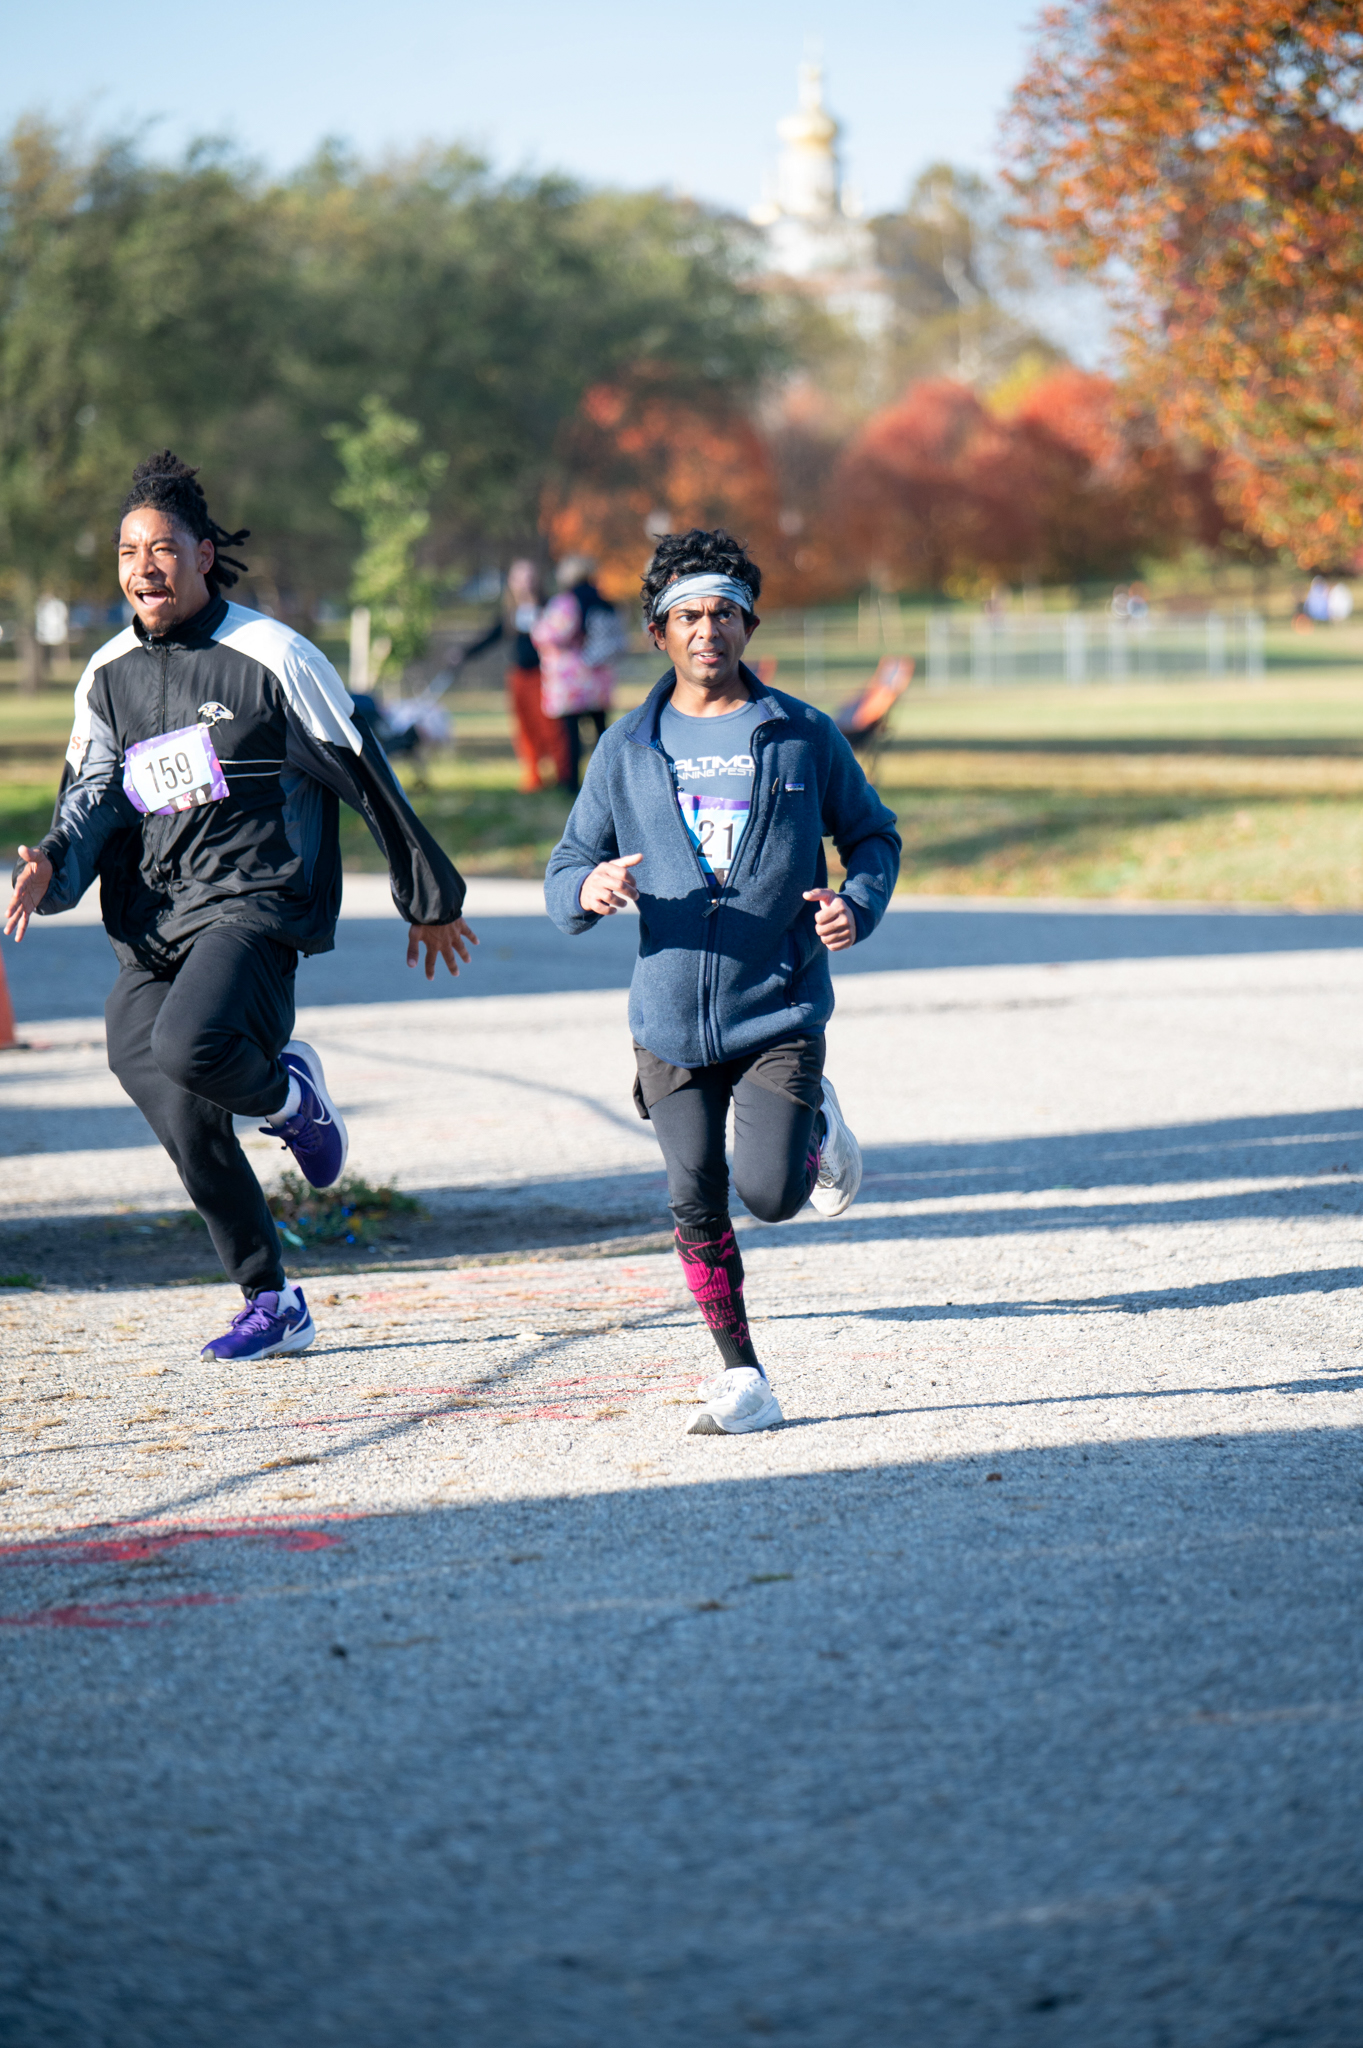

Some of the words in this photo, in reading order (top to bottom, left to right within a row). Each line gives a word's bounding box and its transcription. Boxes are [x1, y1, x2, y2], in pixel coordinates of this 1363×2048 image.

[144, 752, 194, 793] 159
[668, 755, 755, 773] ALTIMO
[696, 819, 734, 861] 21
